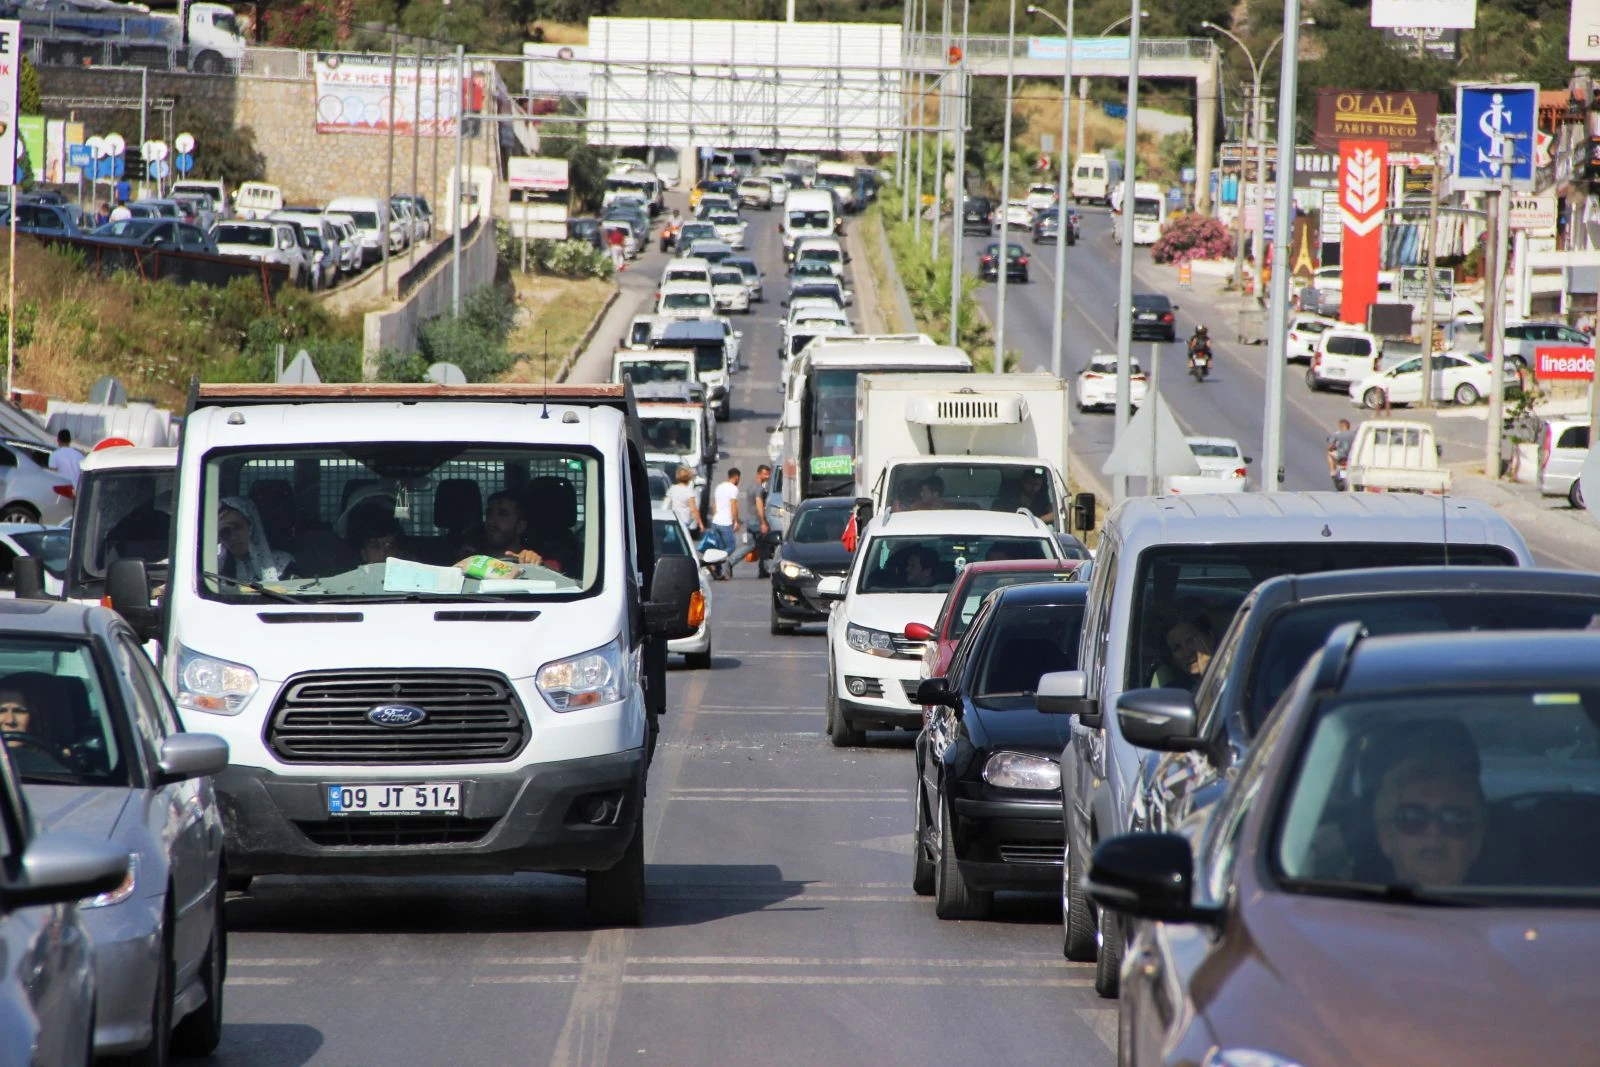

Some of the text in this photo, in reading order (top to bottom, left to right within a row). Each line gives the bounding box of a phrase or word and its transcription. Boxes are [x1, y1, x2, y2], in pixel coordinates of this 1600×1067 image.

[1336, 94, 1417, 115] OLALA
[1335, 123, 1417, 137] PARIS DECO
[381, 707, 412, 722] Ford
[341, 788, 367, 808] 09
[378, 788, 404, 808] JT
[415, 787, 456, 807] 514
